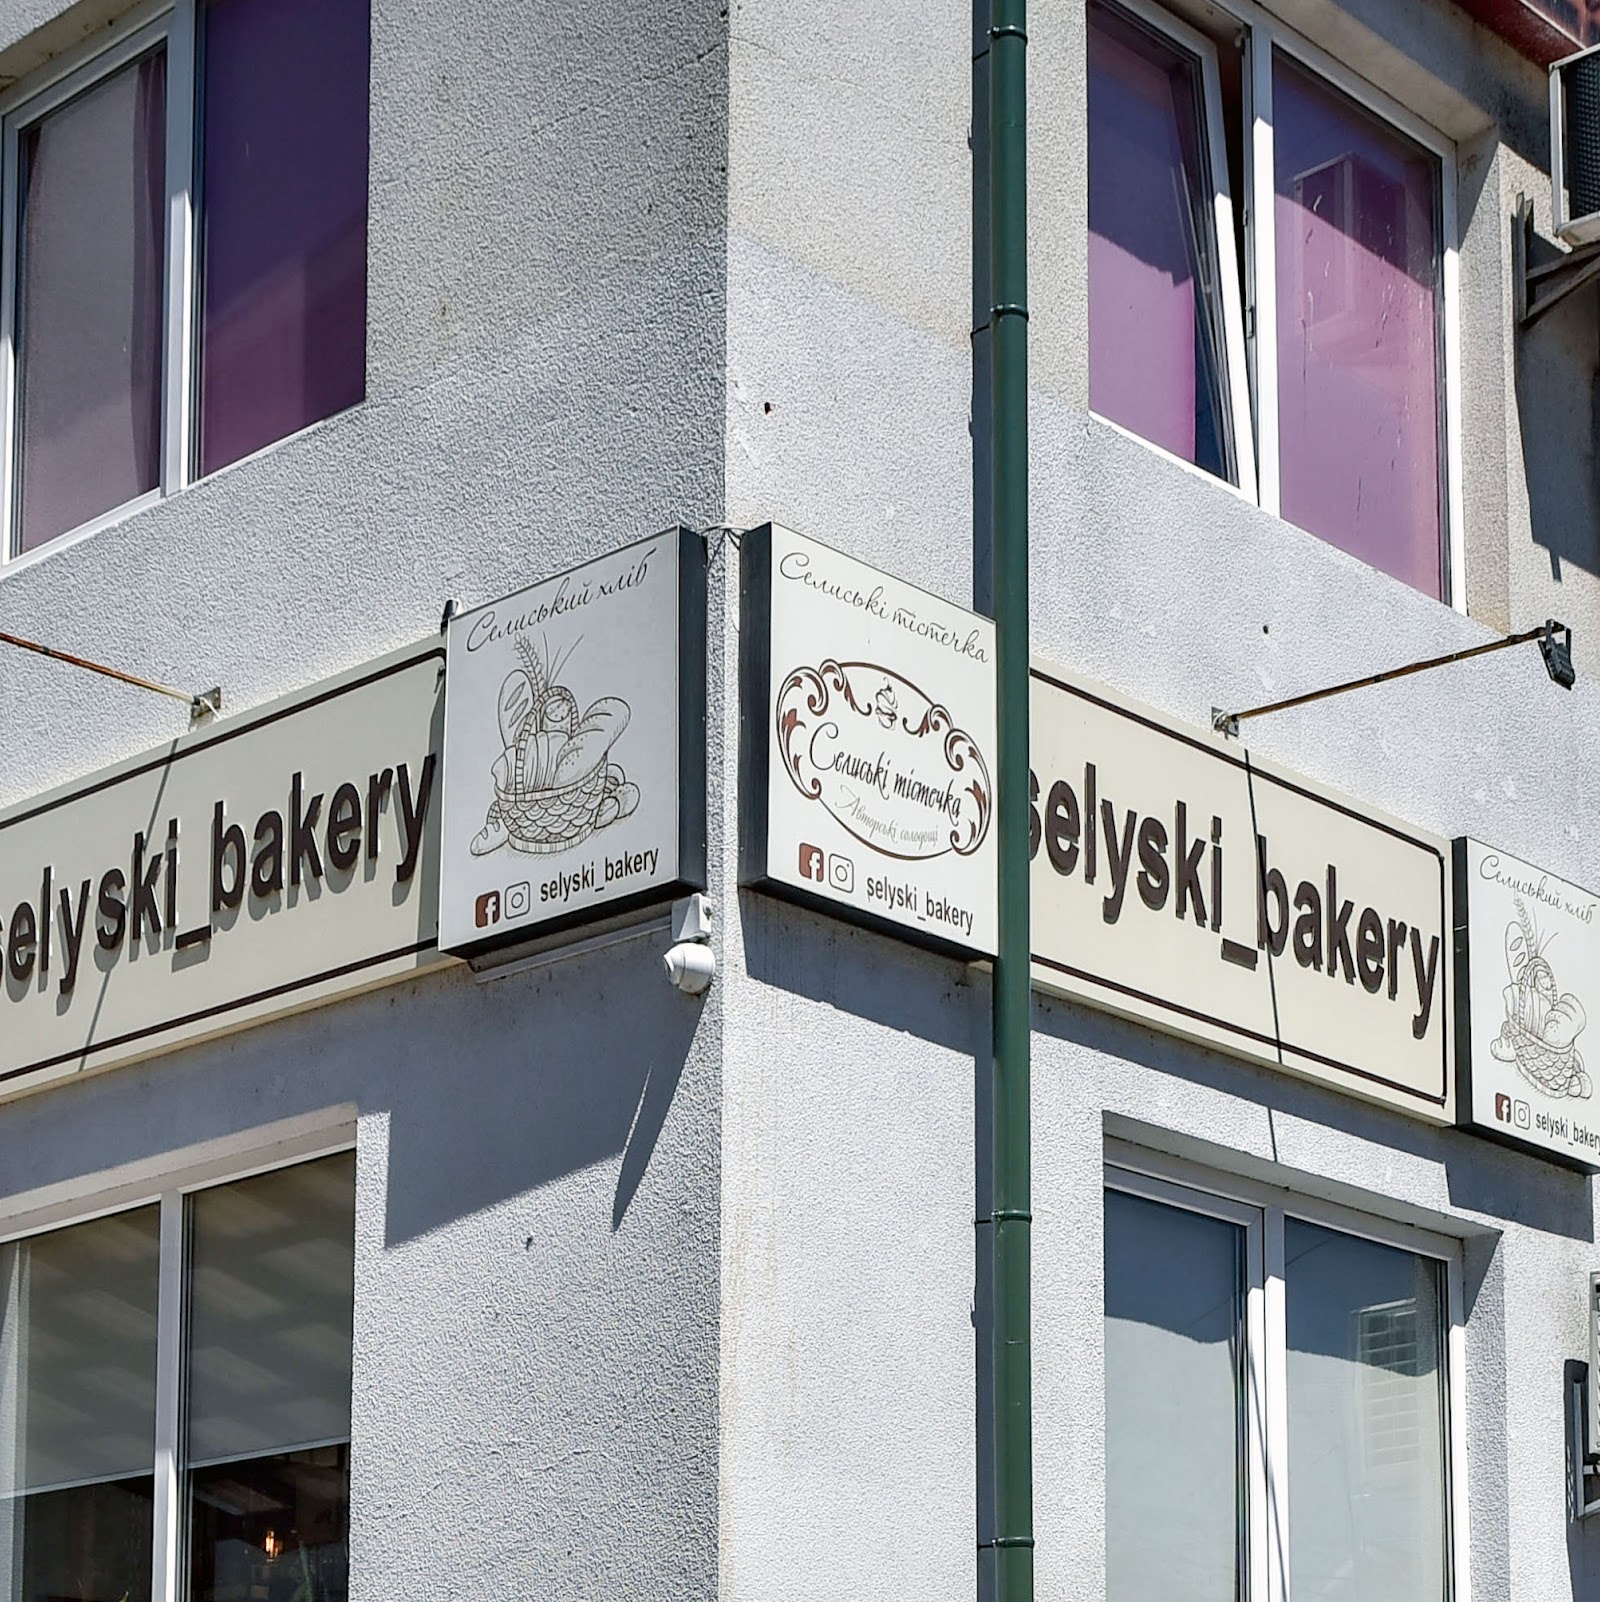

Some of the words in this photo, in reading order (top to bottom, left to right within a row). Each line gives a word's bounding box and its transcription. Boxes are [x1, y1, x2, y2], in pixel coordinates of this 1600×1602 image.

[466, 577, 595, 653] Селиський
[597, 547, 658, 600] хліб
[779, 551, 888, 620] Селиські
[891, 607, 989, 664] тістечка
[809, 721, 891, 801] Селиські
[893, 767, 961, 827] тістечка
[834, 784, 898, 844] Авторські
[539, 846, 659, 903] selyski_bakery
[866, 875, 974, 937] selyski_bakery
[1480, 854, 1563, 910] Селиський
[1565, 903, 1597, 925] хліб
